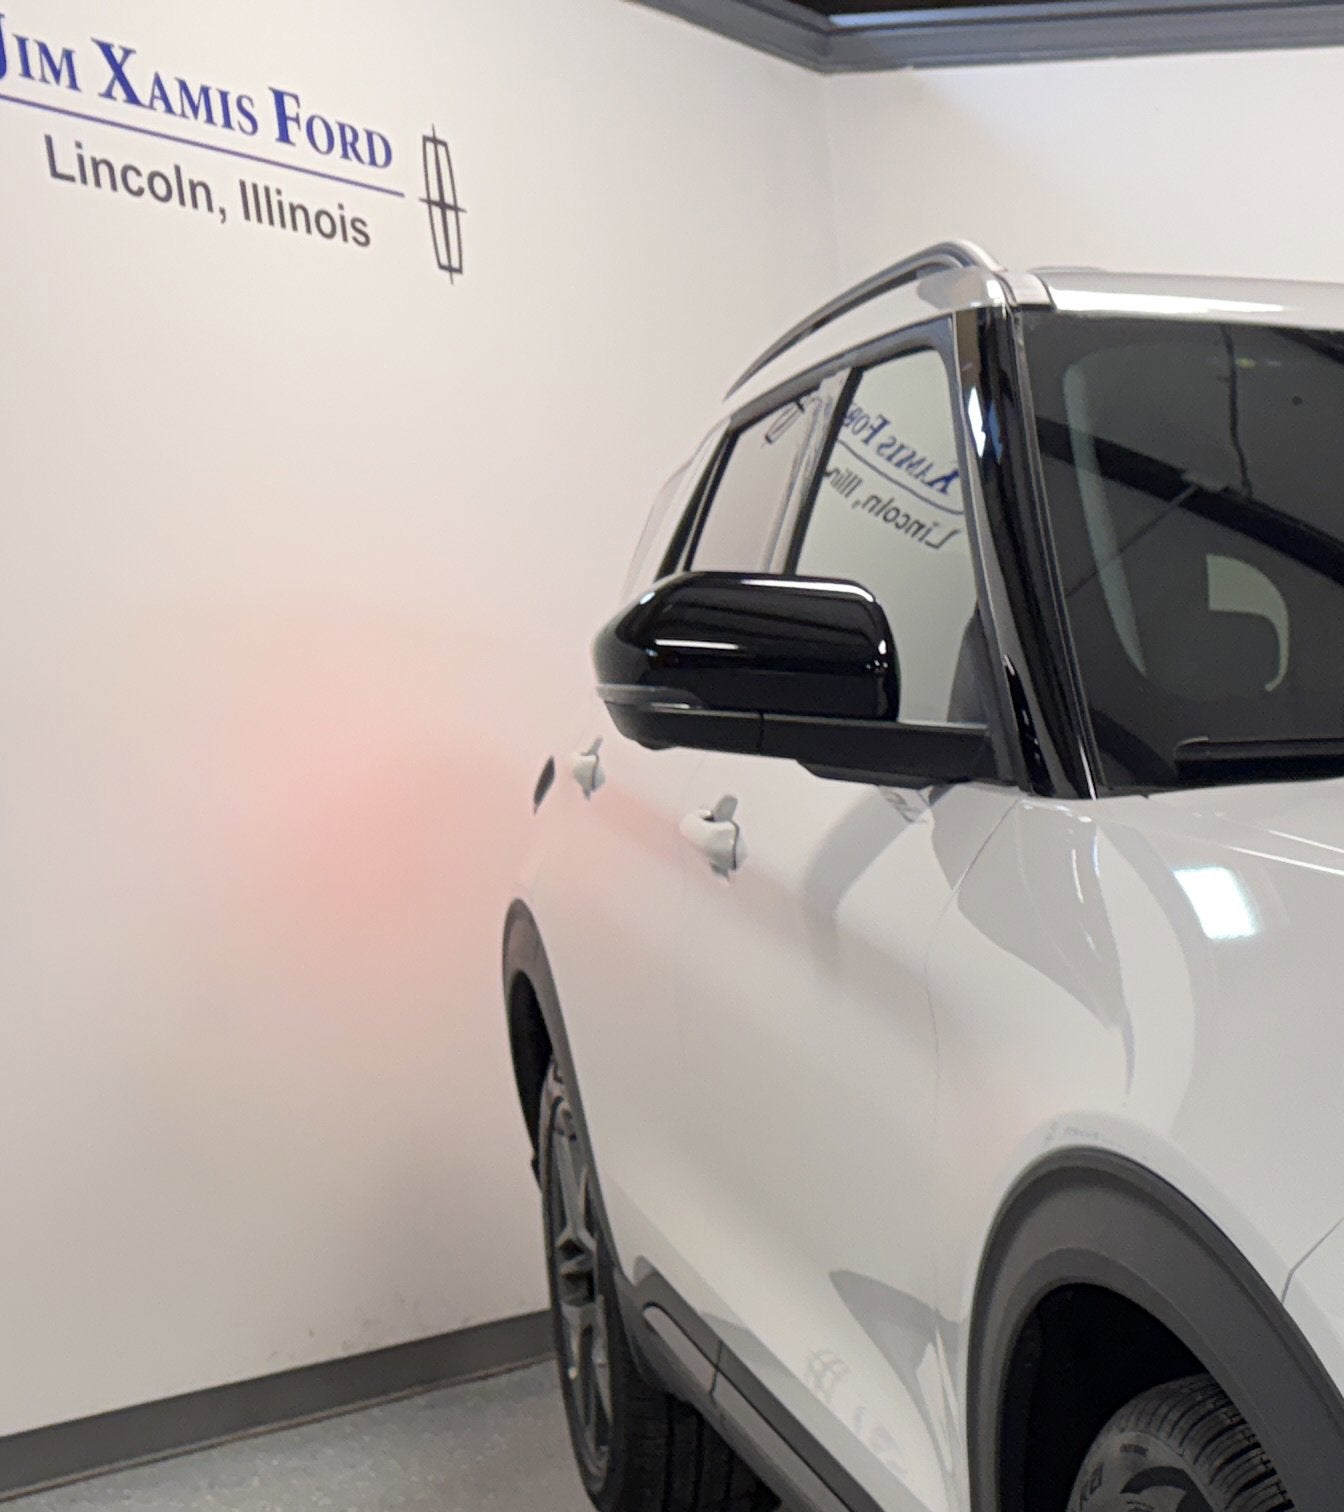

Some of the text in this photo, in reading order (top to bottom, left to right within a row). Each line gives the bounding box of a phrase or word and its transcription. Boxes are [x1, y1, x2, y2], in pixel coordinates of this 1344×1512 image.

[91, 37, 259, 136] XAMIS
[268, 87, 393, 169] FORD
[44, 133, 371, 248] Lincoln, Illinois
